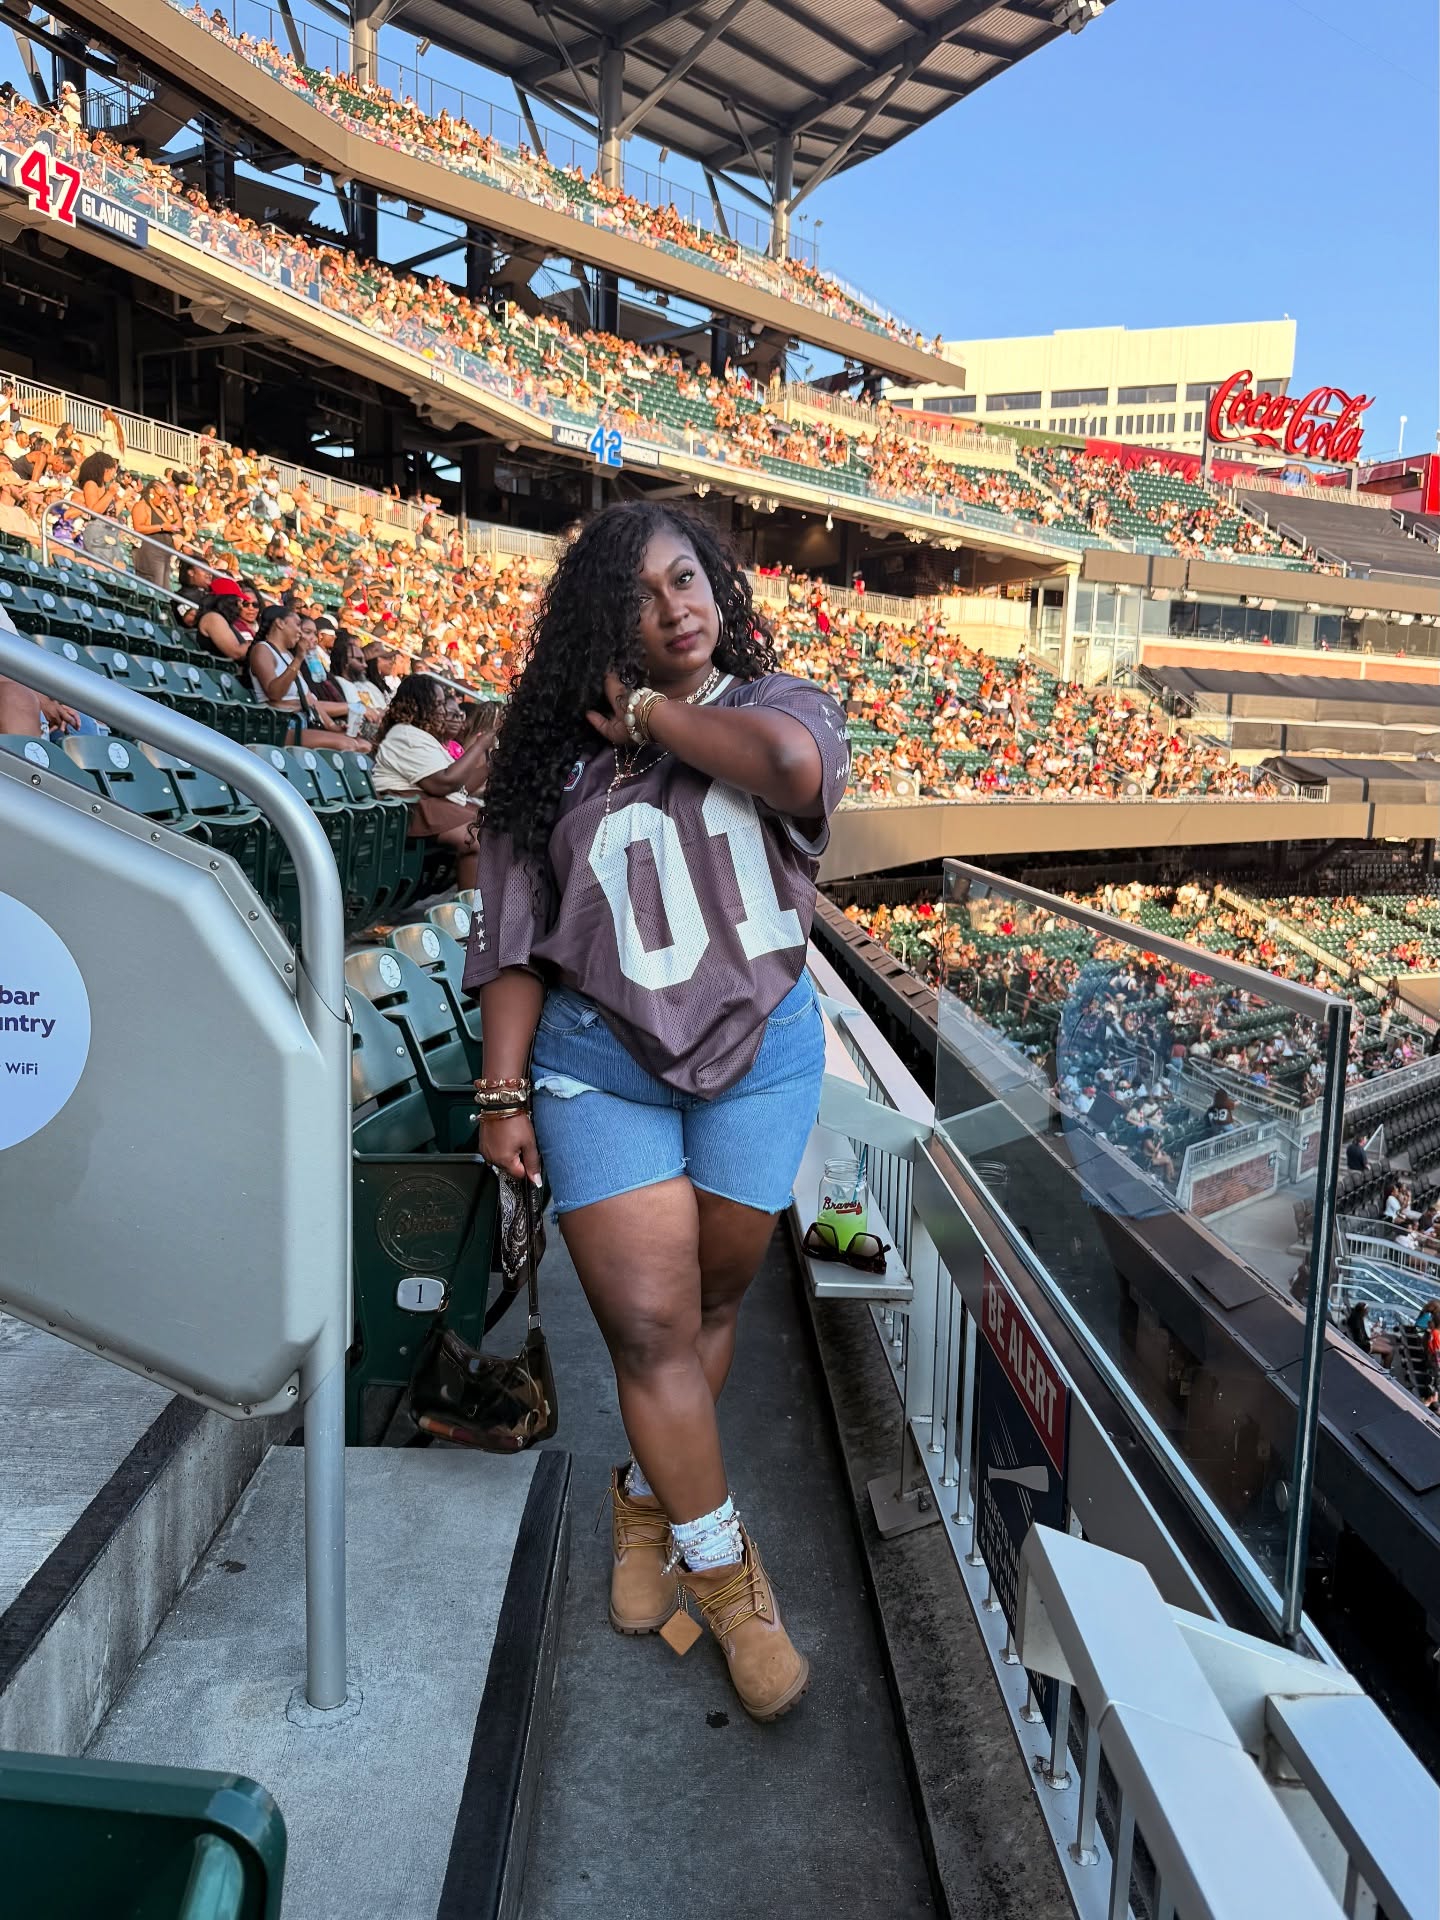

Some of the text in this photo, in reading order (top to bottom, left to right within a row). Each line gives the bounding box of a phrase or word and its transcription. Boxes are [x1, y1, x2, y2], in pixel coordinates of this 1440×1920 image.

[17, 146, 81, 226] 47
[81, 193, 137, 239] GLAVINE
[588, 425, 623, 467] 42
[588, 778, 806, 991] 01
[0, 984, 40, 1006] bar
[5, 1061, 38, 1076] WiFi
[416, 1283, 424, 1304] 1
[988, 1279, 1057, 1438] BE ALERT
[983, 1479, 1019, 1573] OBJECTS MA
[984, 1507, 1018, 1597] THE PLAYIN
[986, 1540, 998, 1580] MAY
[1000, 1572, 1016, 1627] CAUS
